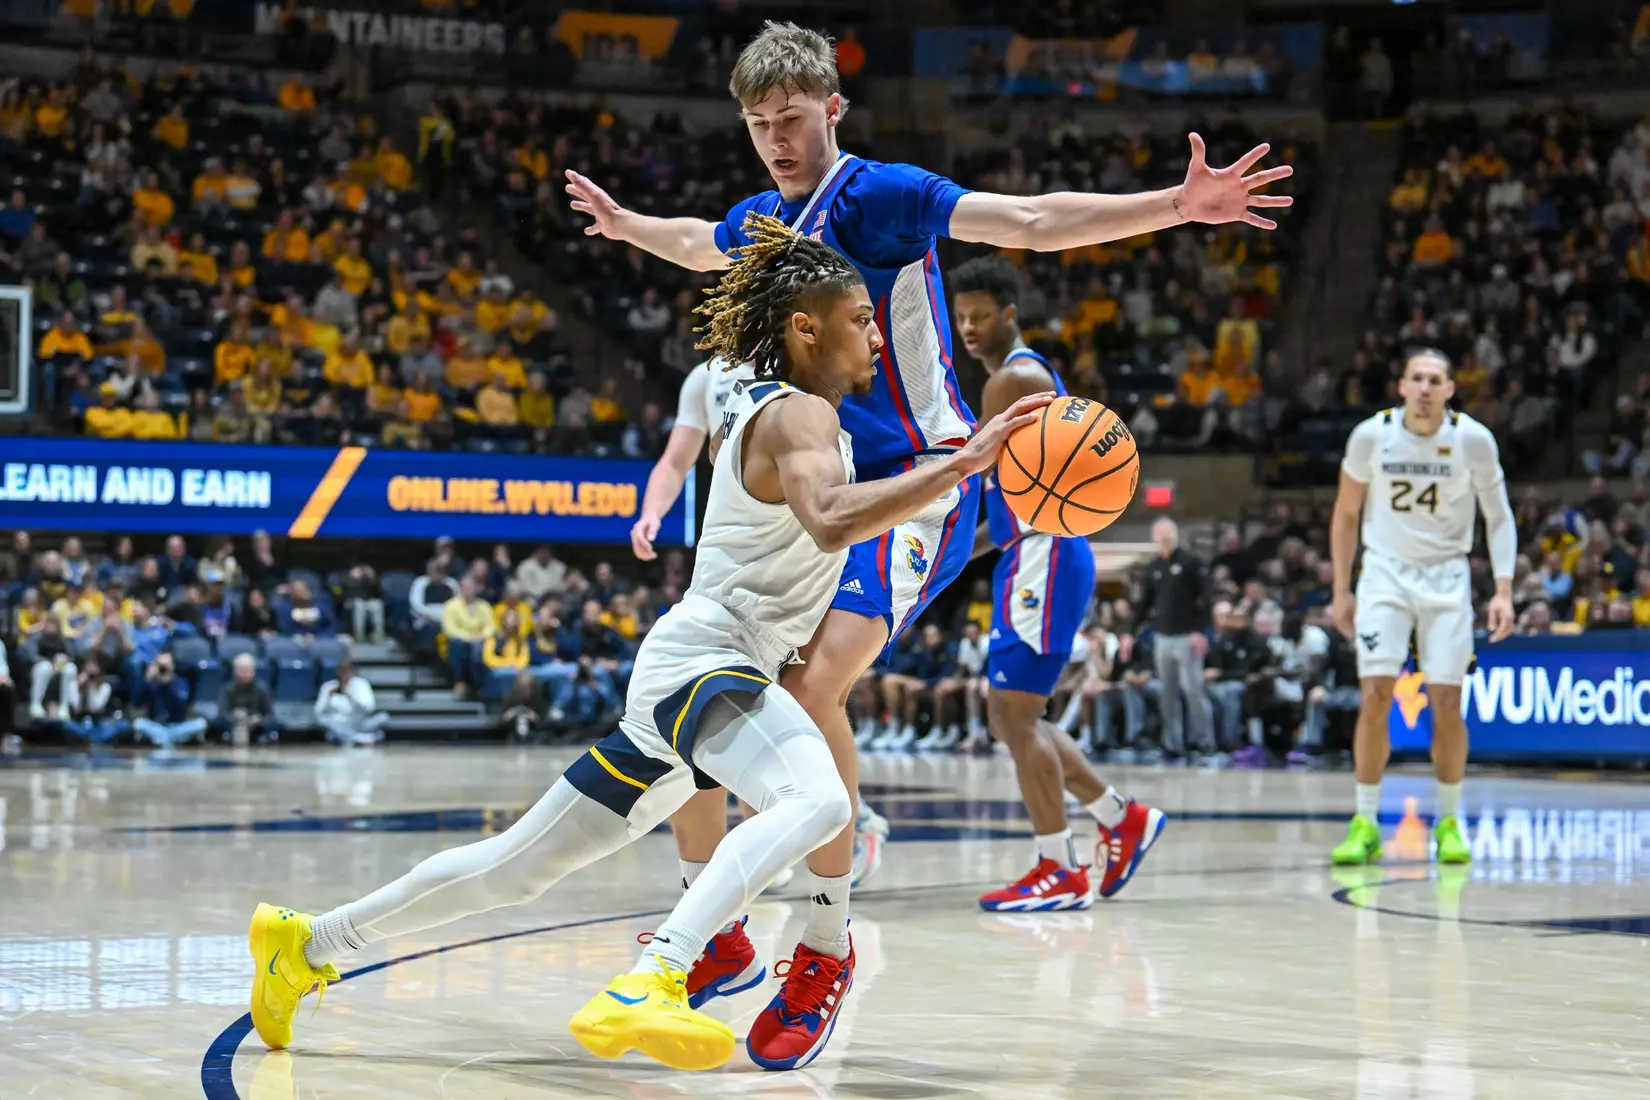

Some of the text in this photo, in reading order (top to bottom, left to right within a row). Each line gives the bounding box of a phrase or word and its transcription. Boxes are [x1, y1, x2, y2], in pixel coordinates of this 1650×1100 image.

[255, 4, 505, 53] MNTAINEERS
[1061, 398, 1093, 423] CAA
[101, 466, 175, 505] AND
[181, 469, 272, 508] EARN
[387, 475, 638, 518] ONLINE.WVU.EDU
[1390, 480, 1438, 514] 24
[839, 585, 865, 595] adidas
